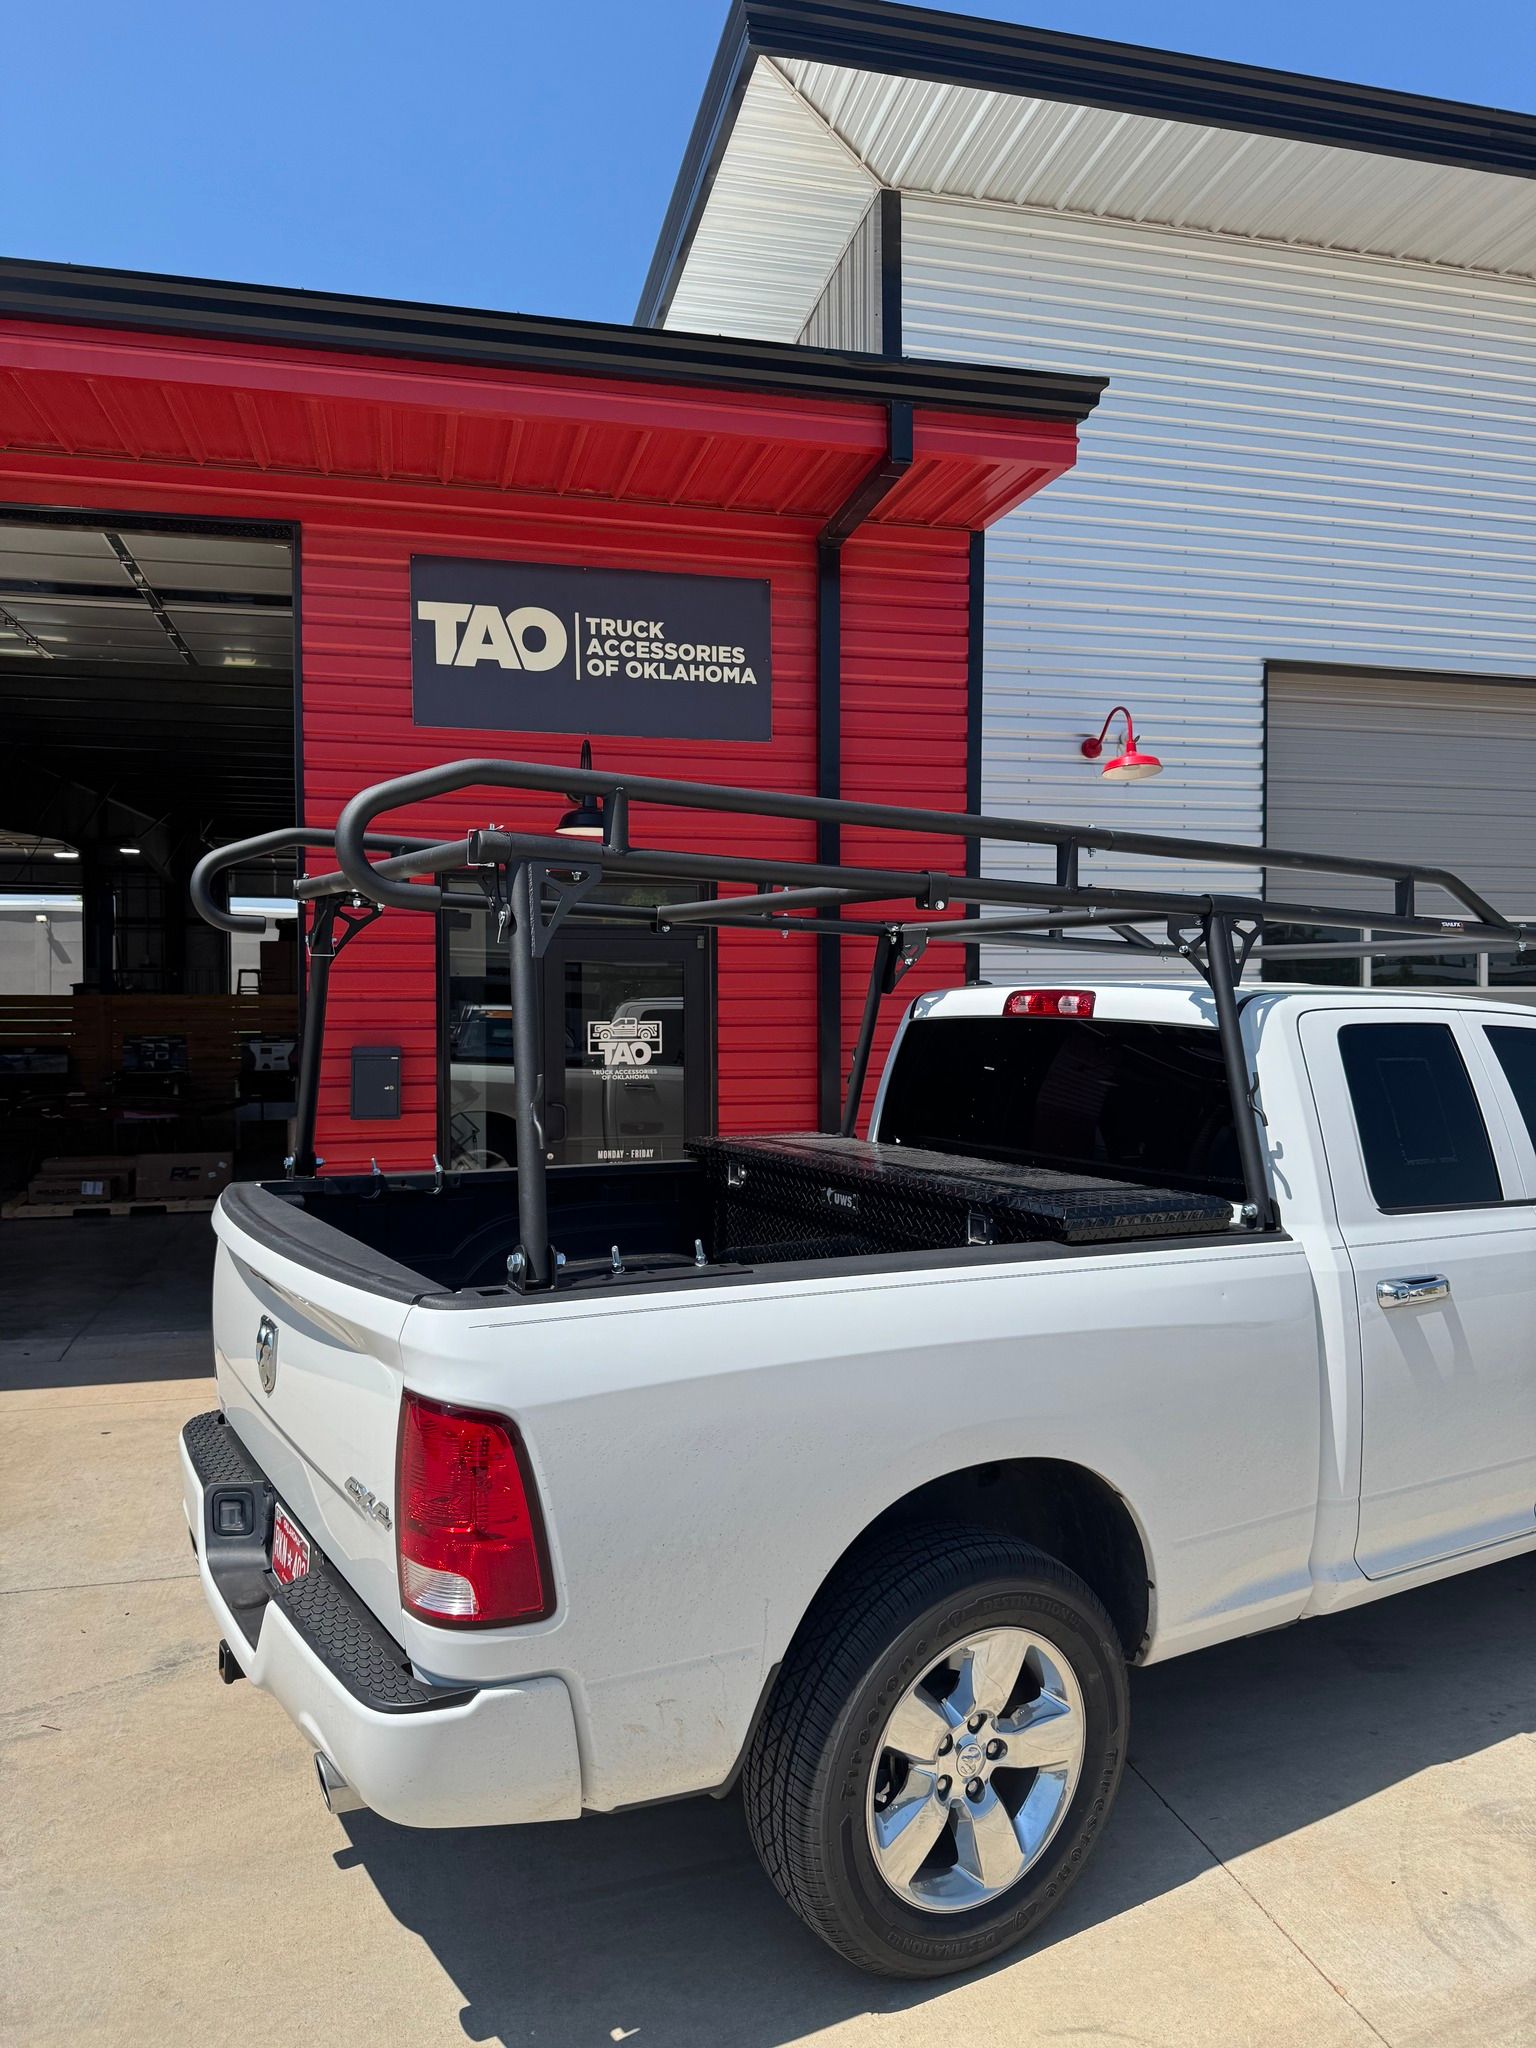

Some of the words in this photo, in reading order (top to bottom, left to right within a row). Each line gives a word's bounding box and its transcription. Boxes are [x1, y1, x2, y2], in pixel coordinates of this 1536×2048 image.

[417, 601, 568, 672] TAO
[585, 617, 664, 640] TRUCK
[586, 640, 745, 663] ACCESSORIES
[586, 659, 619, 677] OF
[625, 661, 757, 684] OKLAHOMA
[598, 1041, 652, 1066] TAO
[597, 1150, 624, 1160] MONDAY
[631, 1149, 654, 1158] FRIDAY
[834, 1193, 853, 1208] UWS
